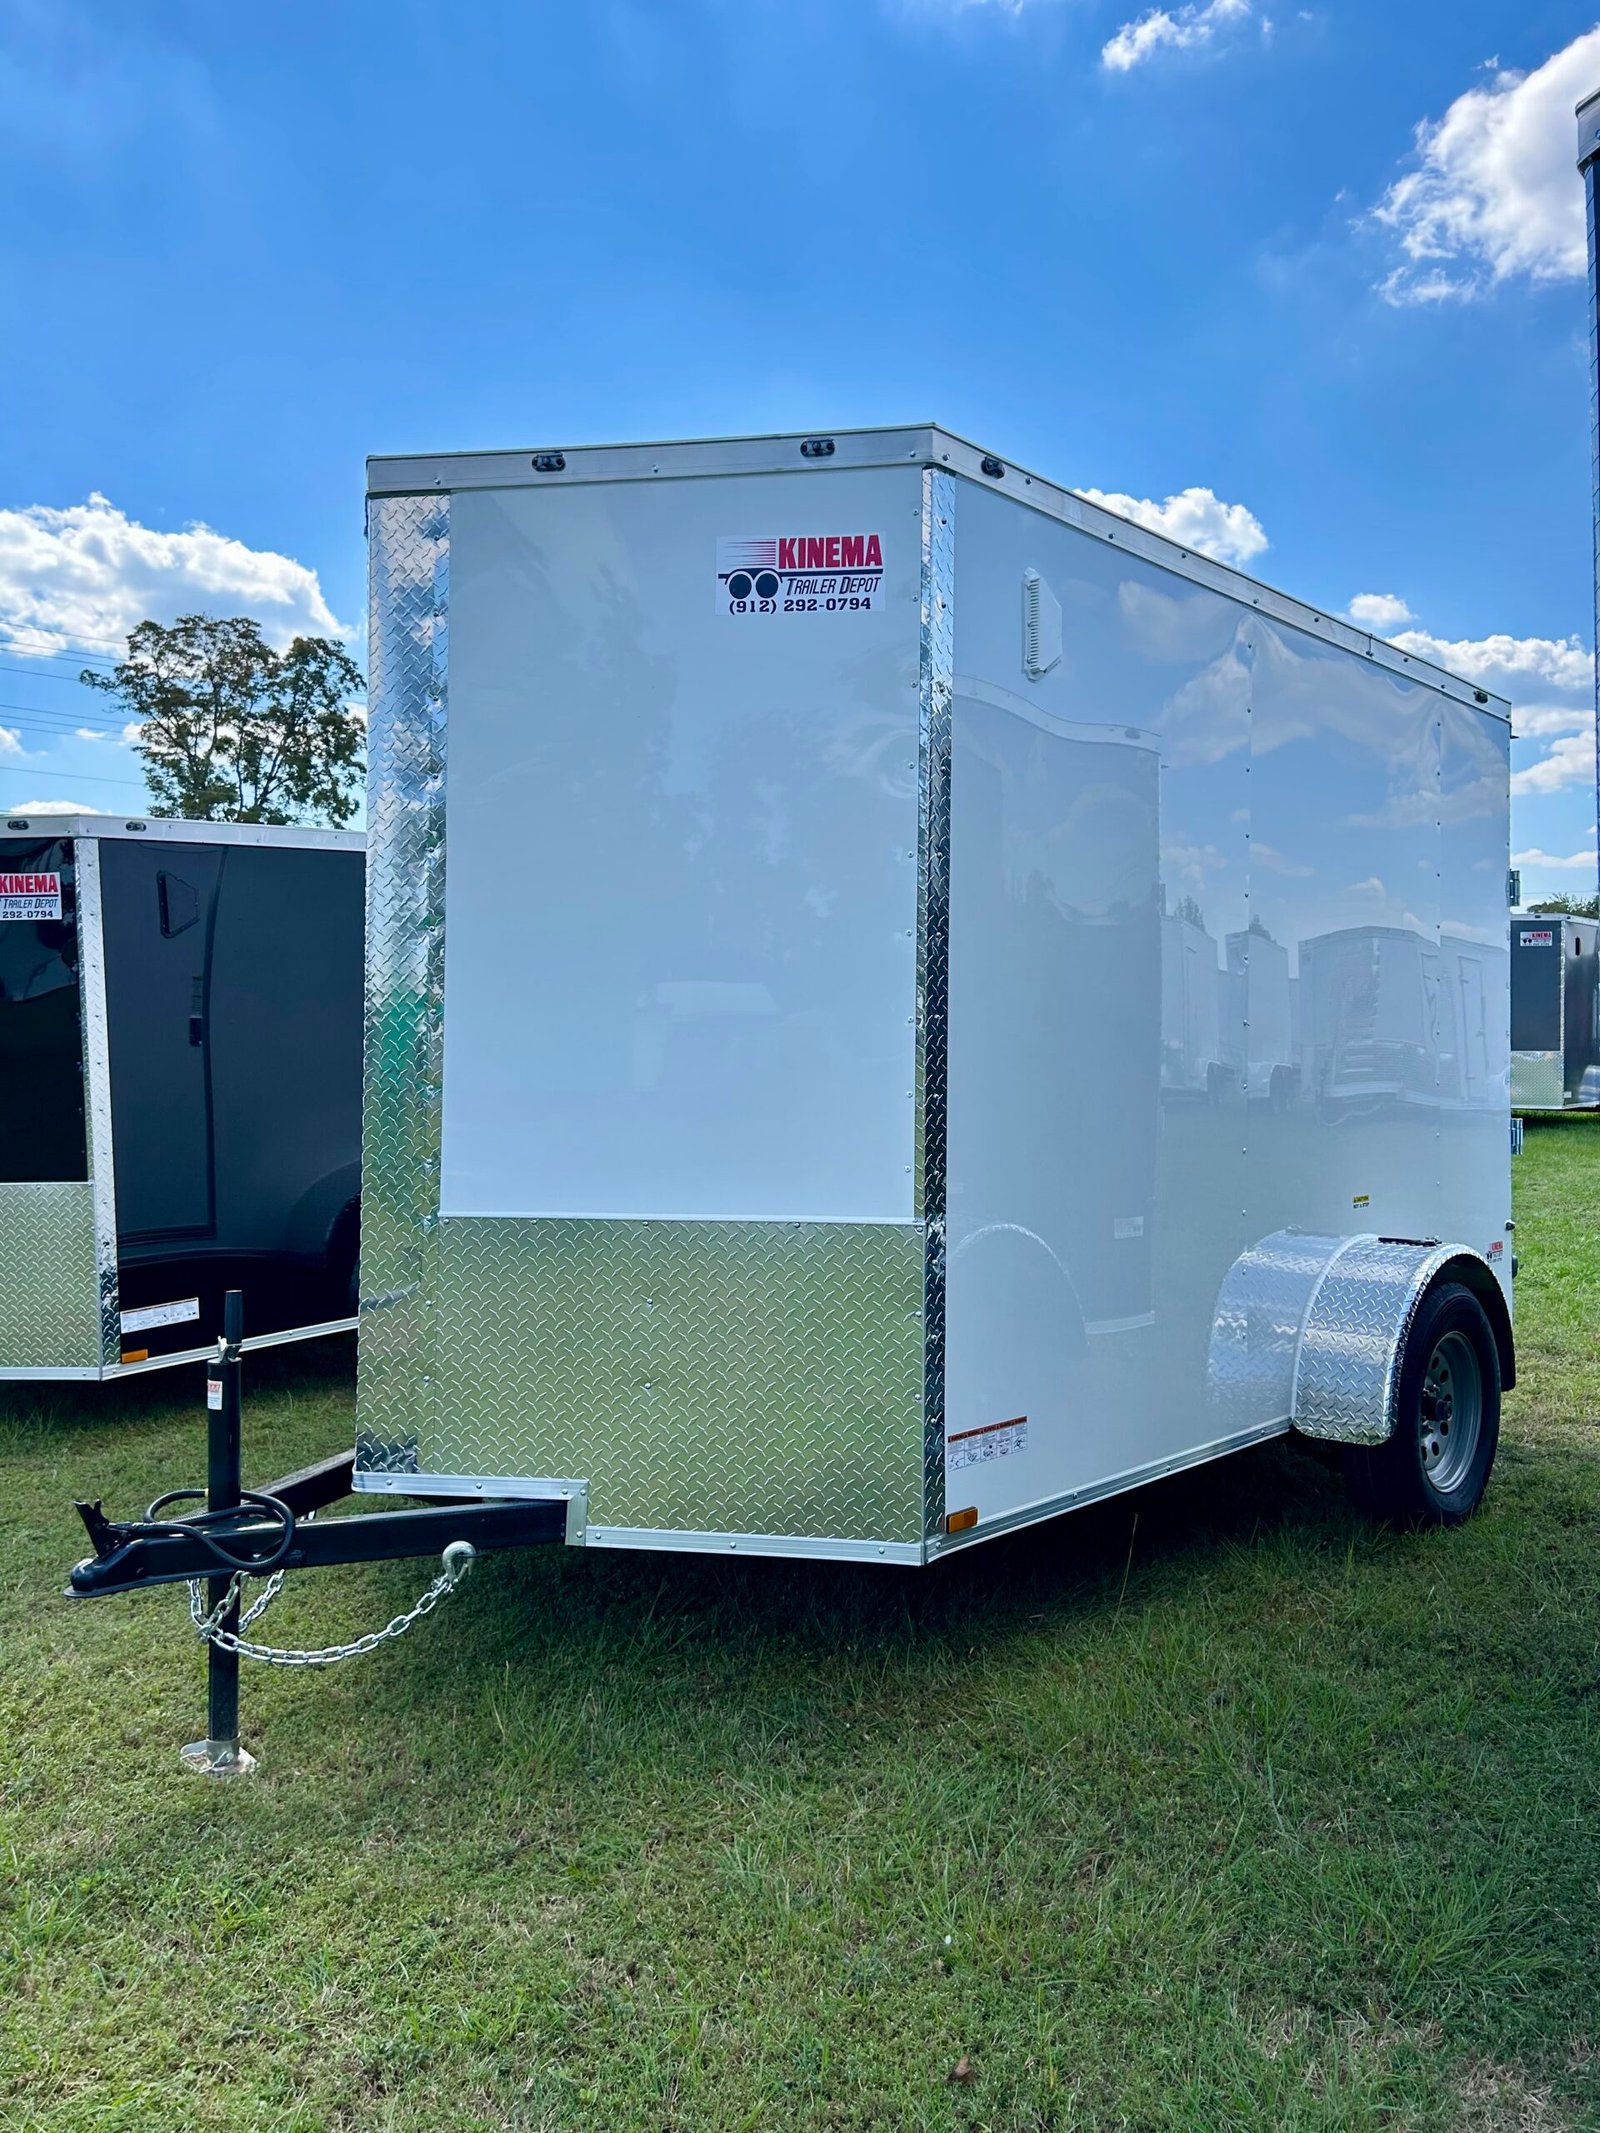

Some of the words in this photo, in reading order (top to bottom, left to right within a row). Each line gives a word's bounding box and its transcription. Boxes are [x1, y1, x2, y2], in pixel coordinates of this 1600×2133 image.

[779, 534, 882, 569] KINEMA
[786, 577, 837, 596] TRAILER
[839, 576, 881, 594] DEPOT
[729, 599, 777, 615] (912)
[783, 597, 871, 612] 292-0794
[0, 874, 58, 893] KINEMA
[3, 898, 33, 909] TRAILER
[34, 898, 58, 909] DEPOT
[2, 910, 54, 919] 292-0794
